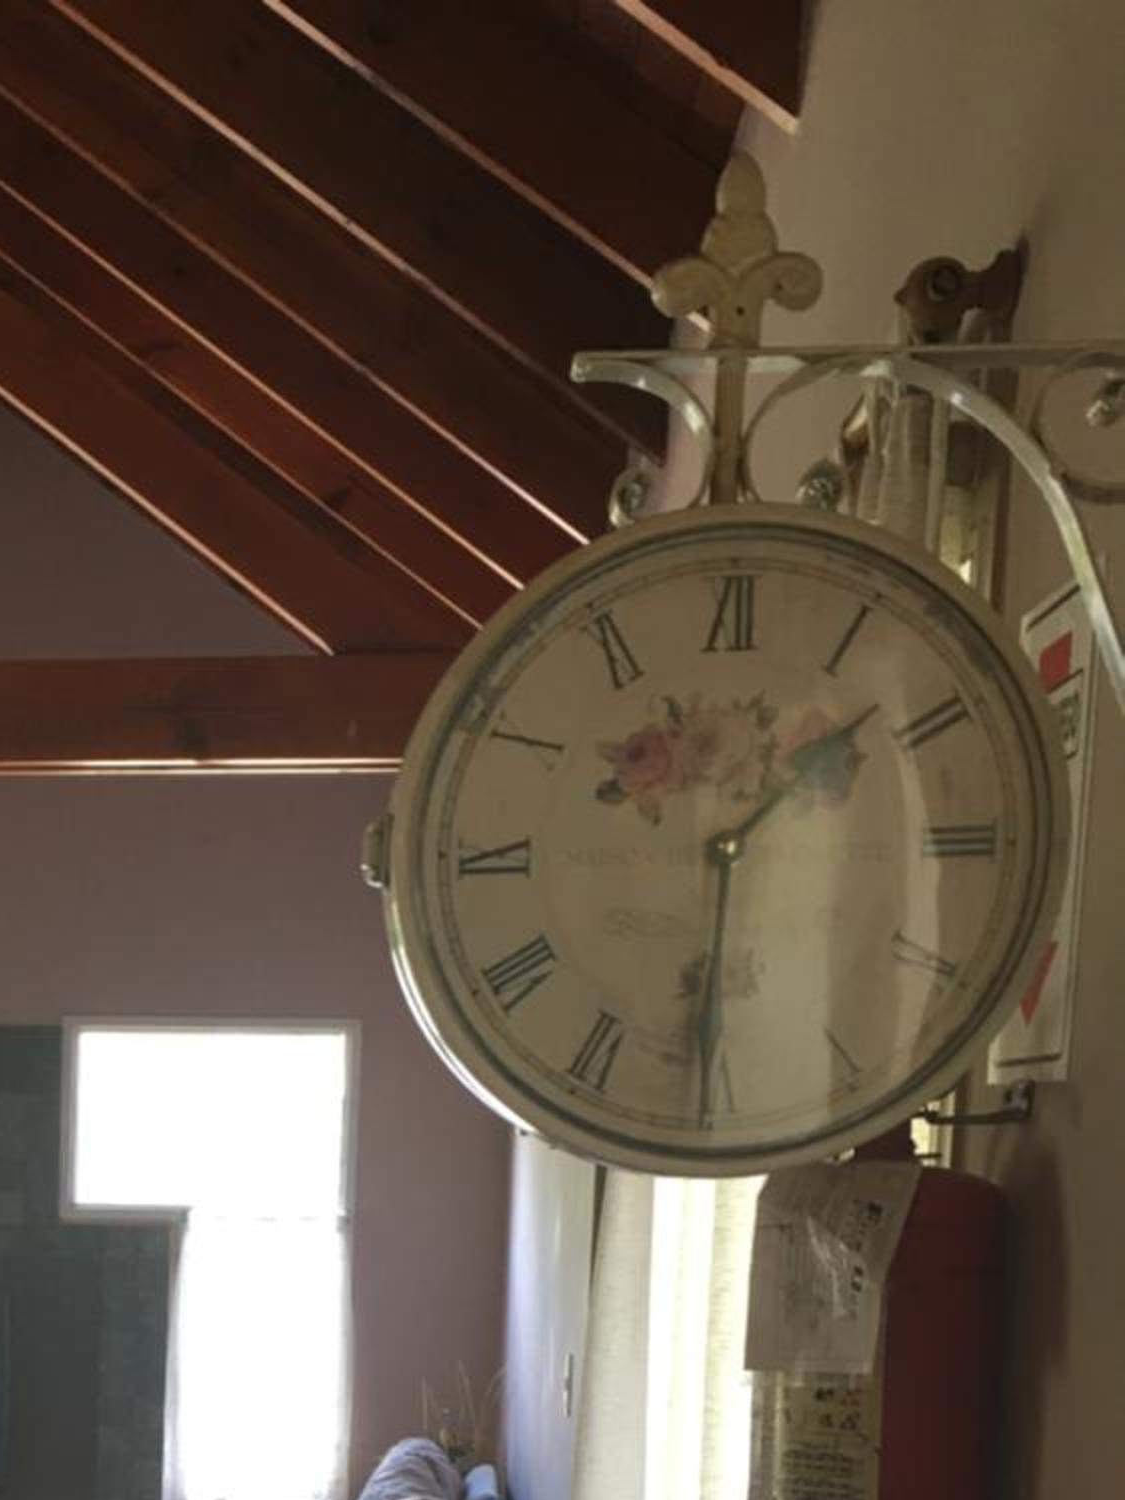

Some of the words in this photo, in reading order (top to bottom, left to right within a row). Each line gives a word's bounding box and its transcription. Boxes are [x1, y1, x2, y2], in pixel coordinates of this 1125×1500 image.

[704, 576, 756, 653] XII
[821, 604, 872, 677] I
[892, 688, 976, 754] II
[923, 818, 1000, 863] III
